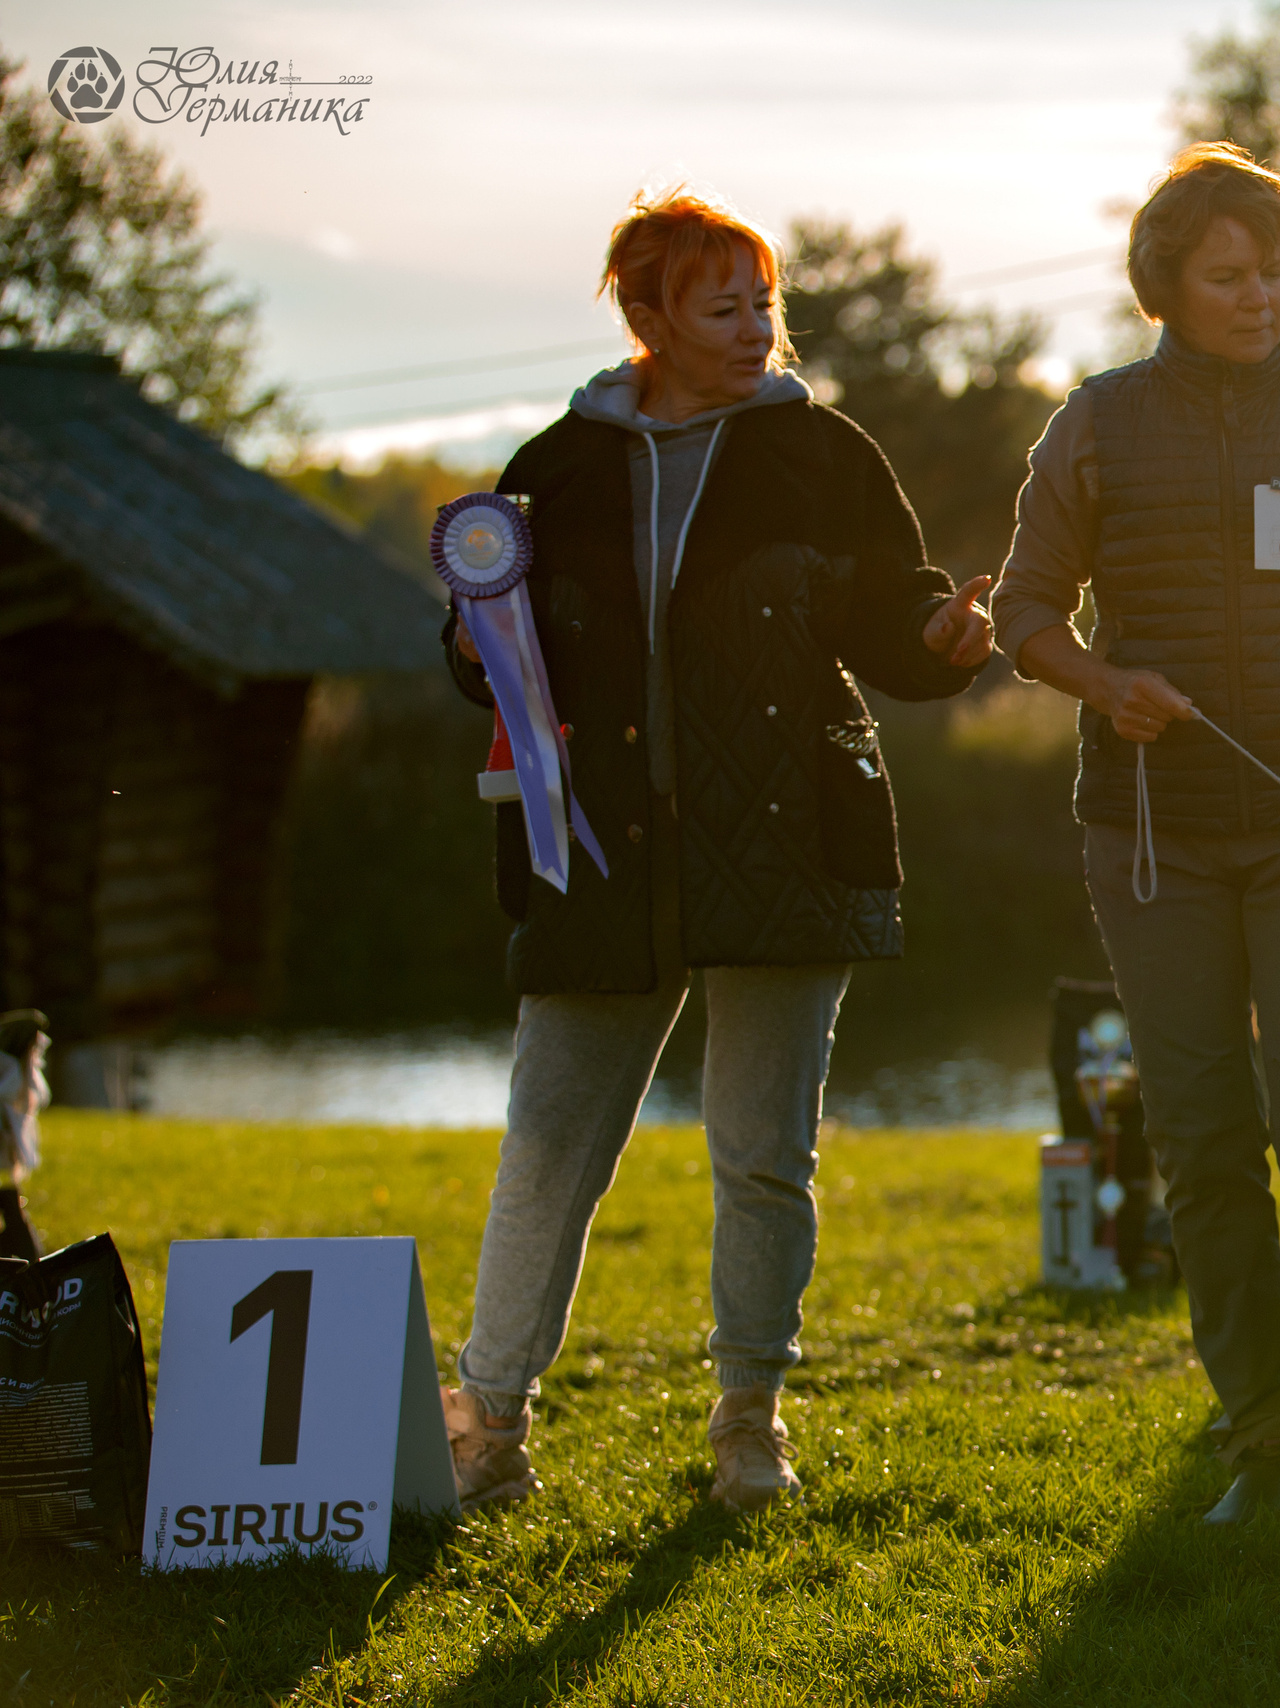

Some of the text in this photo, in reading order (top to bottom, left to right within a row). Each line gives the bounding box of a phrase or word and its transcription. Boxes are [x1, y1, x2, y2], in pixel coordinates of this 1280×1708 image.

[230, 1270, 313, 1465] 1
[157, 1506, 169, 1549] PREMIUM
[173, 1500, 365, 1548] SIRIUS
